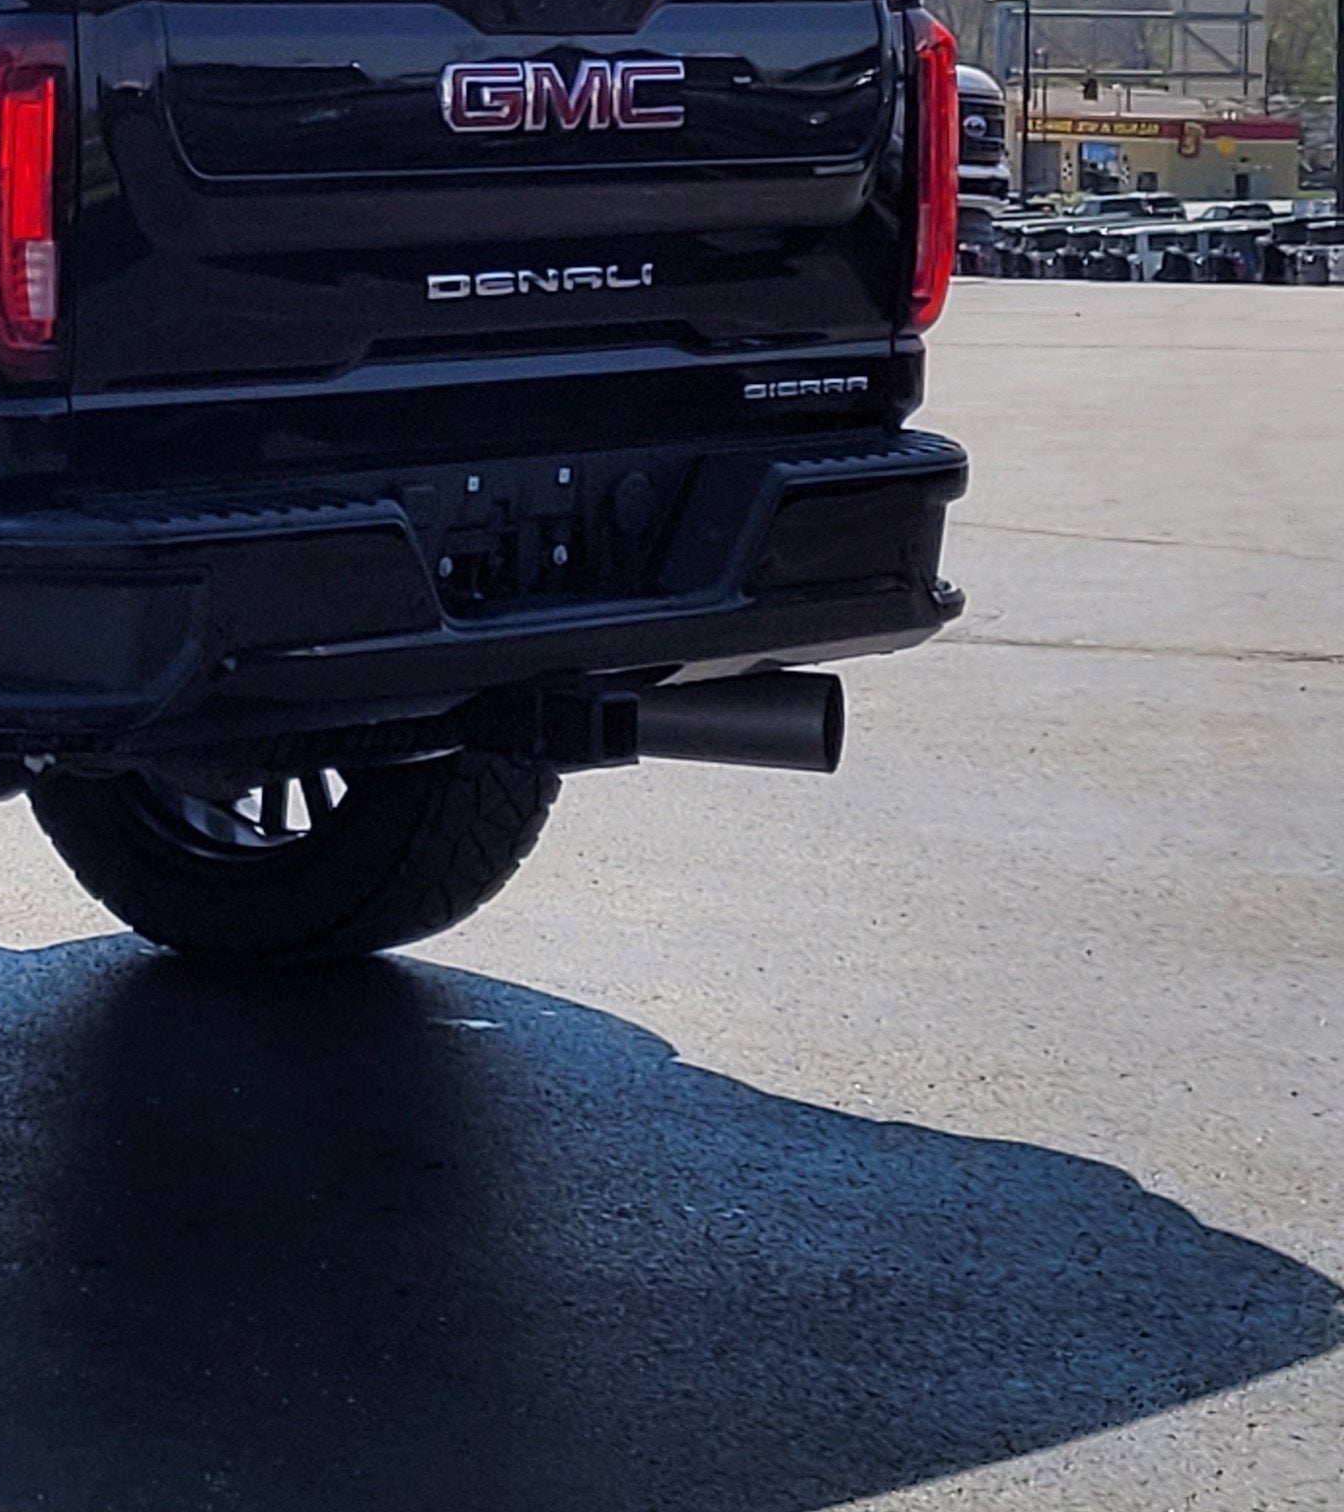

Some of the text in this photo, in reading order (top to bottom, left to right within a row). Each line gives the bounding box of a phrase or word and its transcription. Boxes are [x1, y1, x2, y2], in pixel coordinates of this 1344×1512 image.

[442, 60, 685, 132] GMC
[426, 263, 653, 299] DENALI
[744, 376, 868, 399] SIERRA
